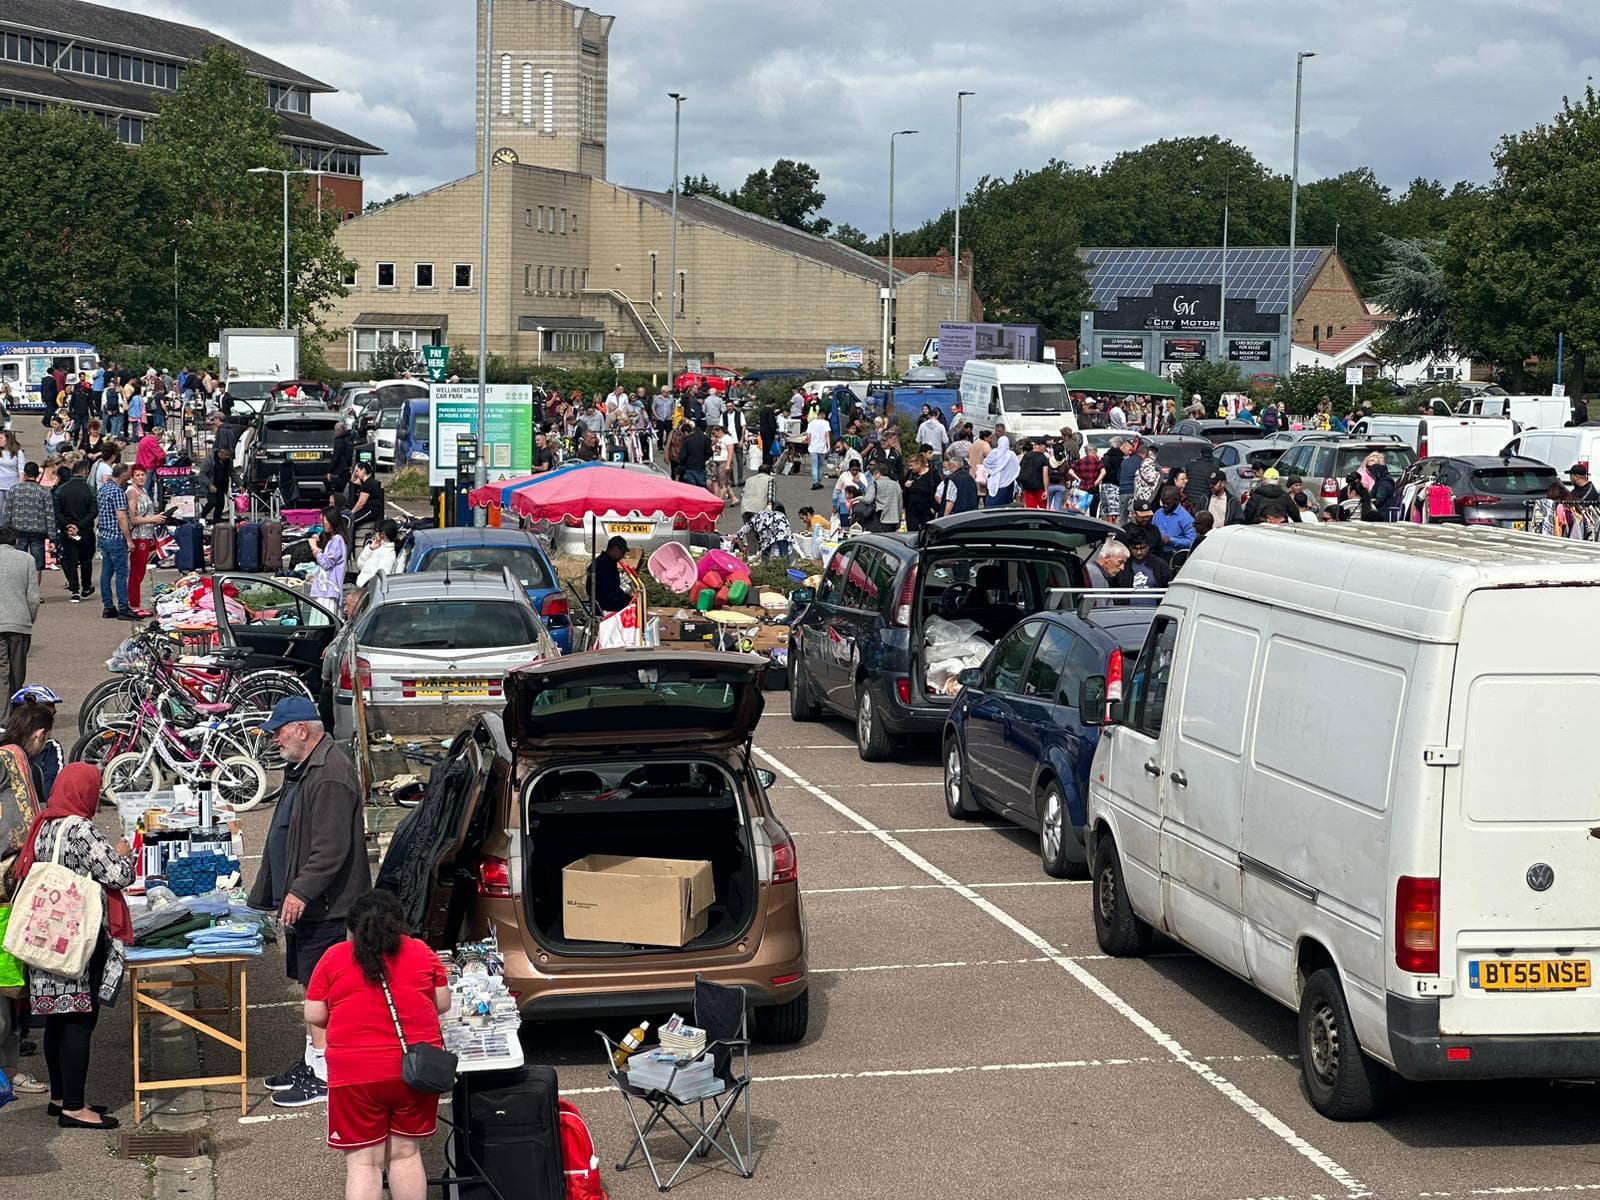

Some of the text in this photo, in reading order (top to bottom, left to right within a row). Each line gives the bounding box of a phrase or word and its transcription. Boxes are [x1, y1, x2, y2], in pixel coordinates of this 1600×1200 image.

[1181, 319, 1221, 327] MOTORS
[430, 349, 442, 358] PAY
[428, 358, 445, 367] HERE
[1486, 961, 1588, 984] BT55 NSE
